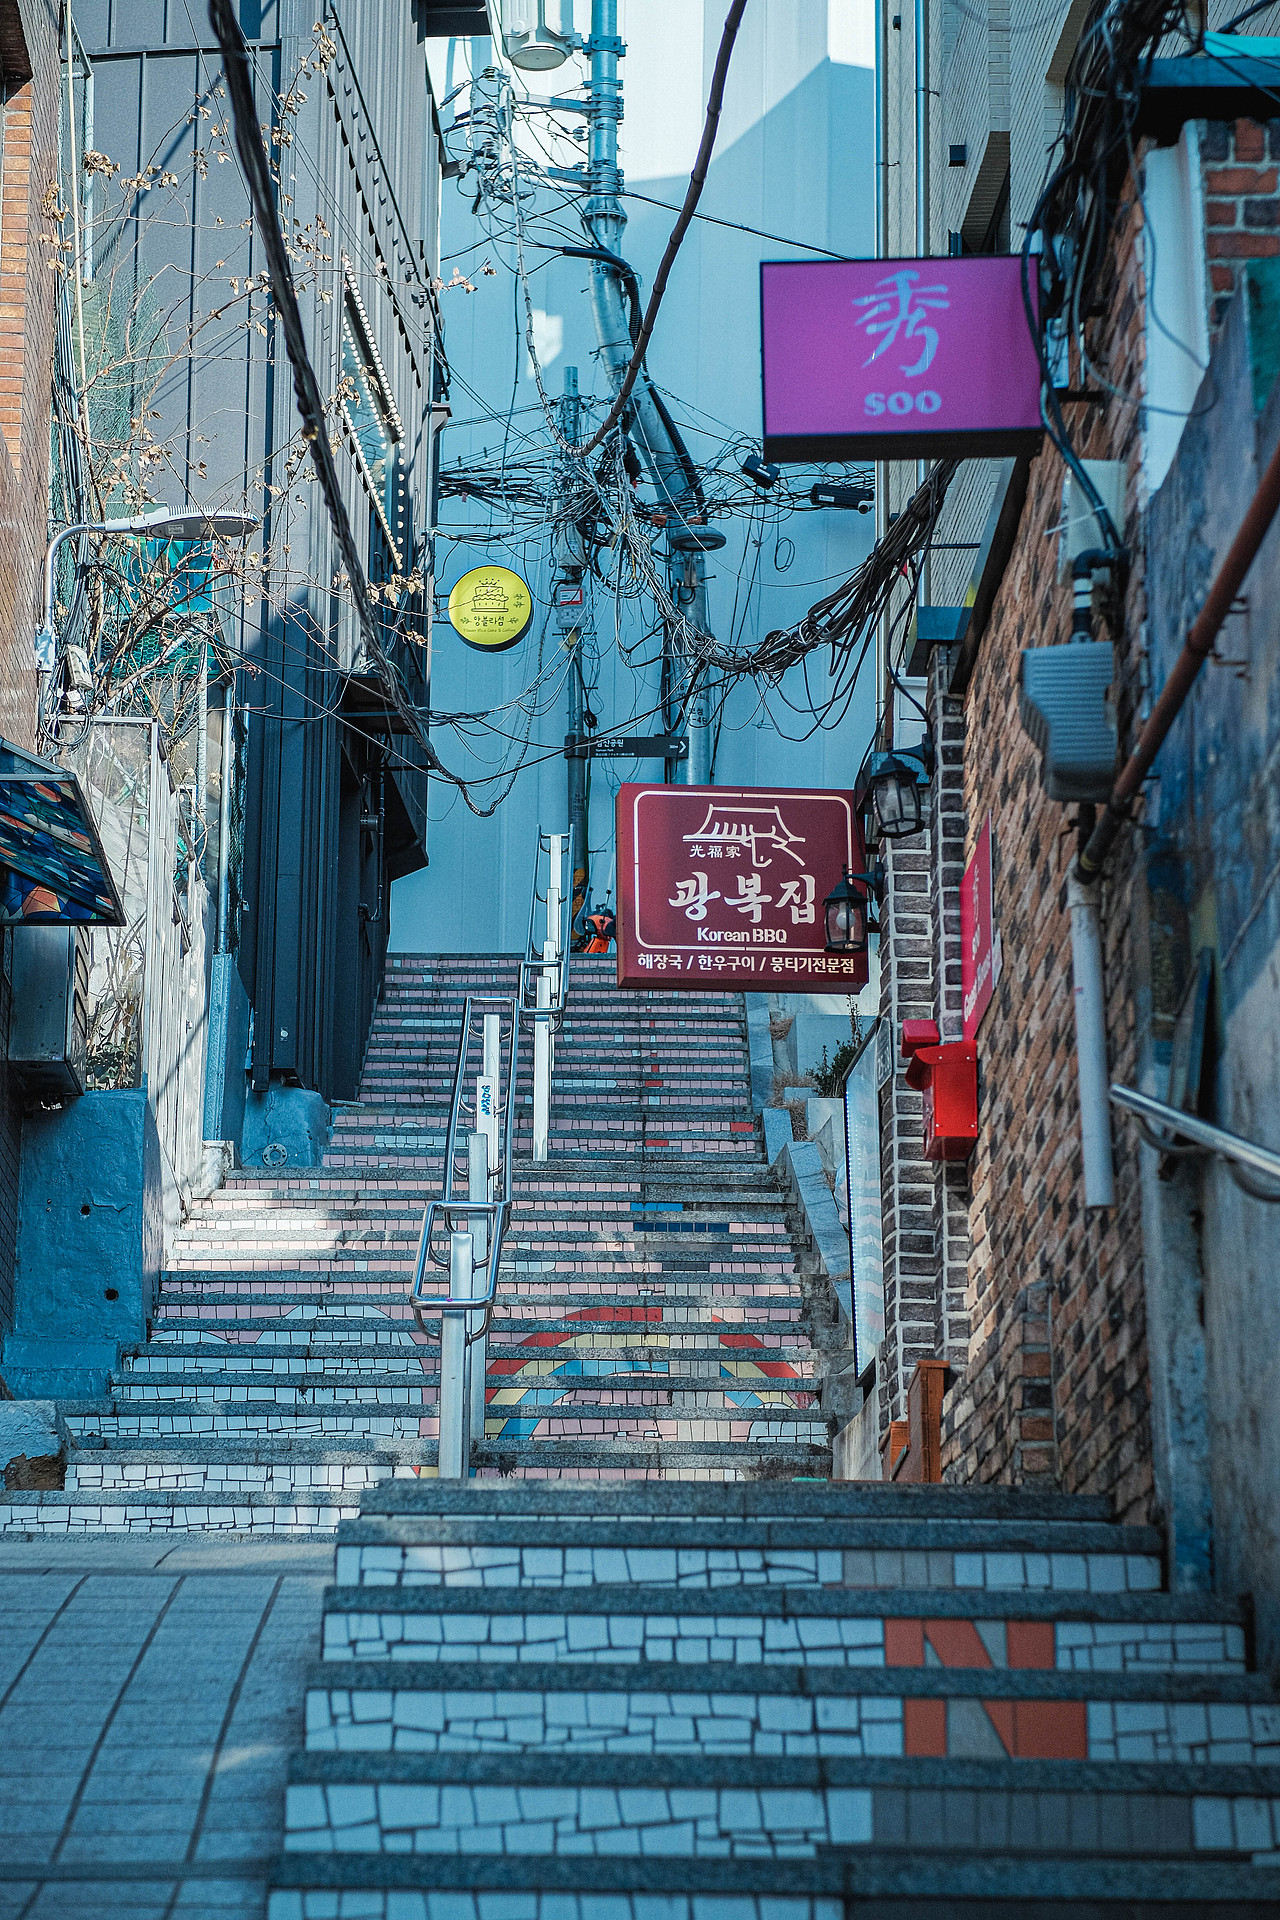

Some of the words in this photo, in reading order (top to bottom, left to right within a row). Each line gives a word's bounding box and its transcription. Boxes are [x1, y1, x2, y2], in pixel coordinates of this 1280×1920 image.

[851, 269, 950, 378] 秀
[689, 845, 741, 859] 光福家
[697, 927, 750, 943] Korean
[752, 928, 787, 944] BBQ
[637, 953, 683, 970] 해장국
[697, 954, 756, 972] 한우구이
[770, 956, 855, 974] 뭉티기전문점
